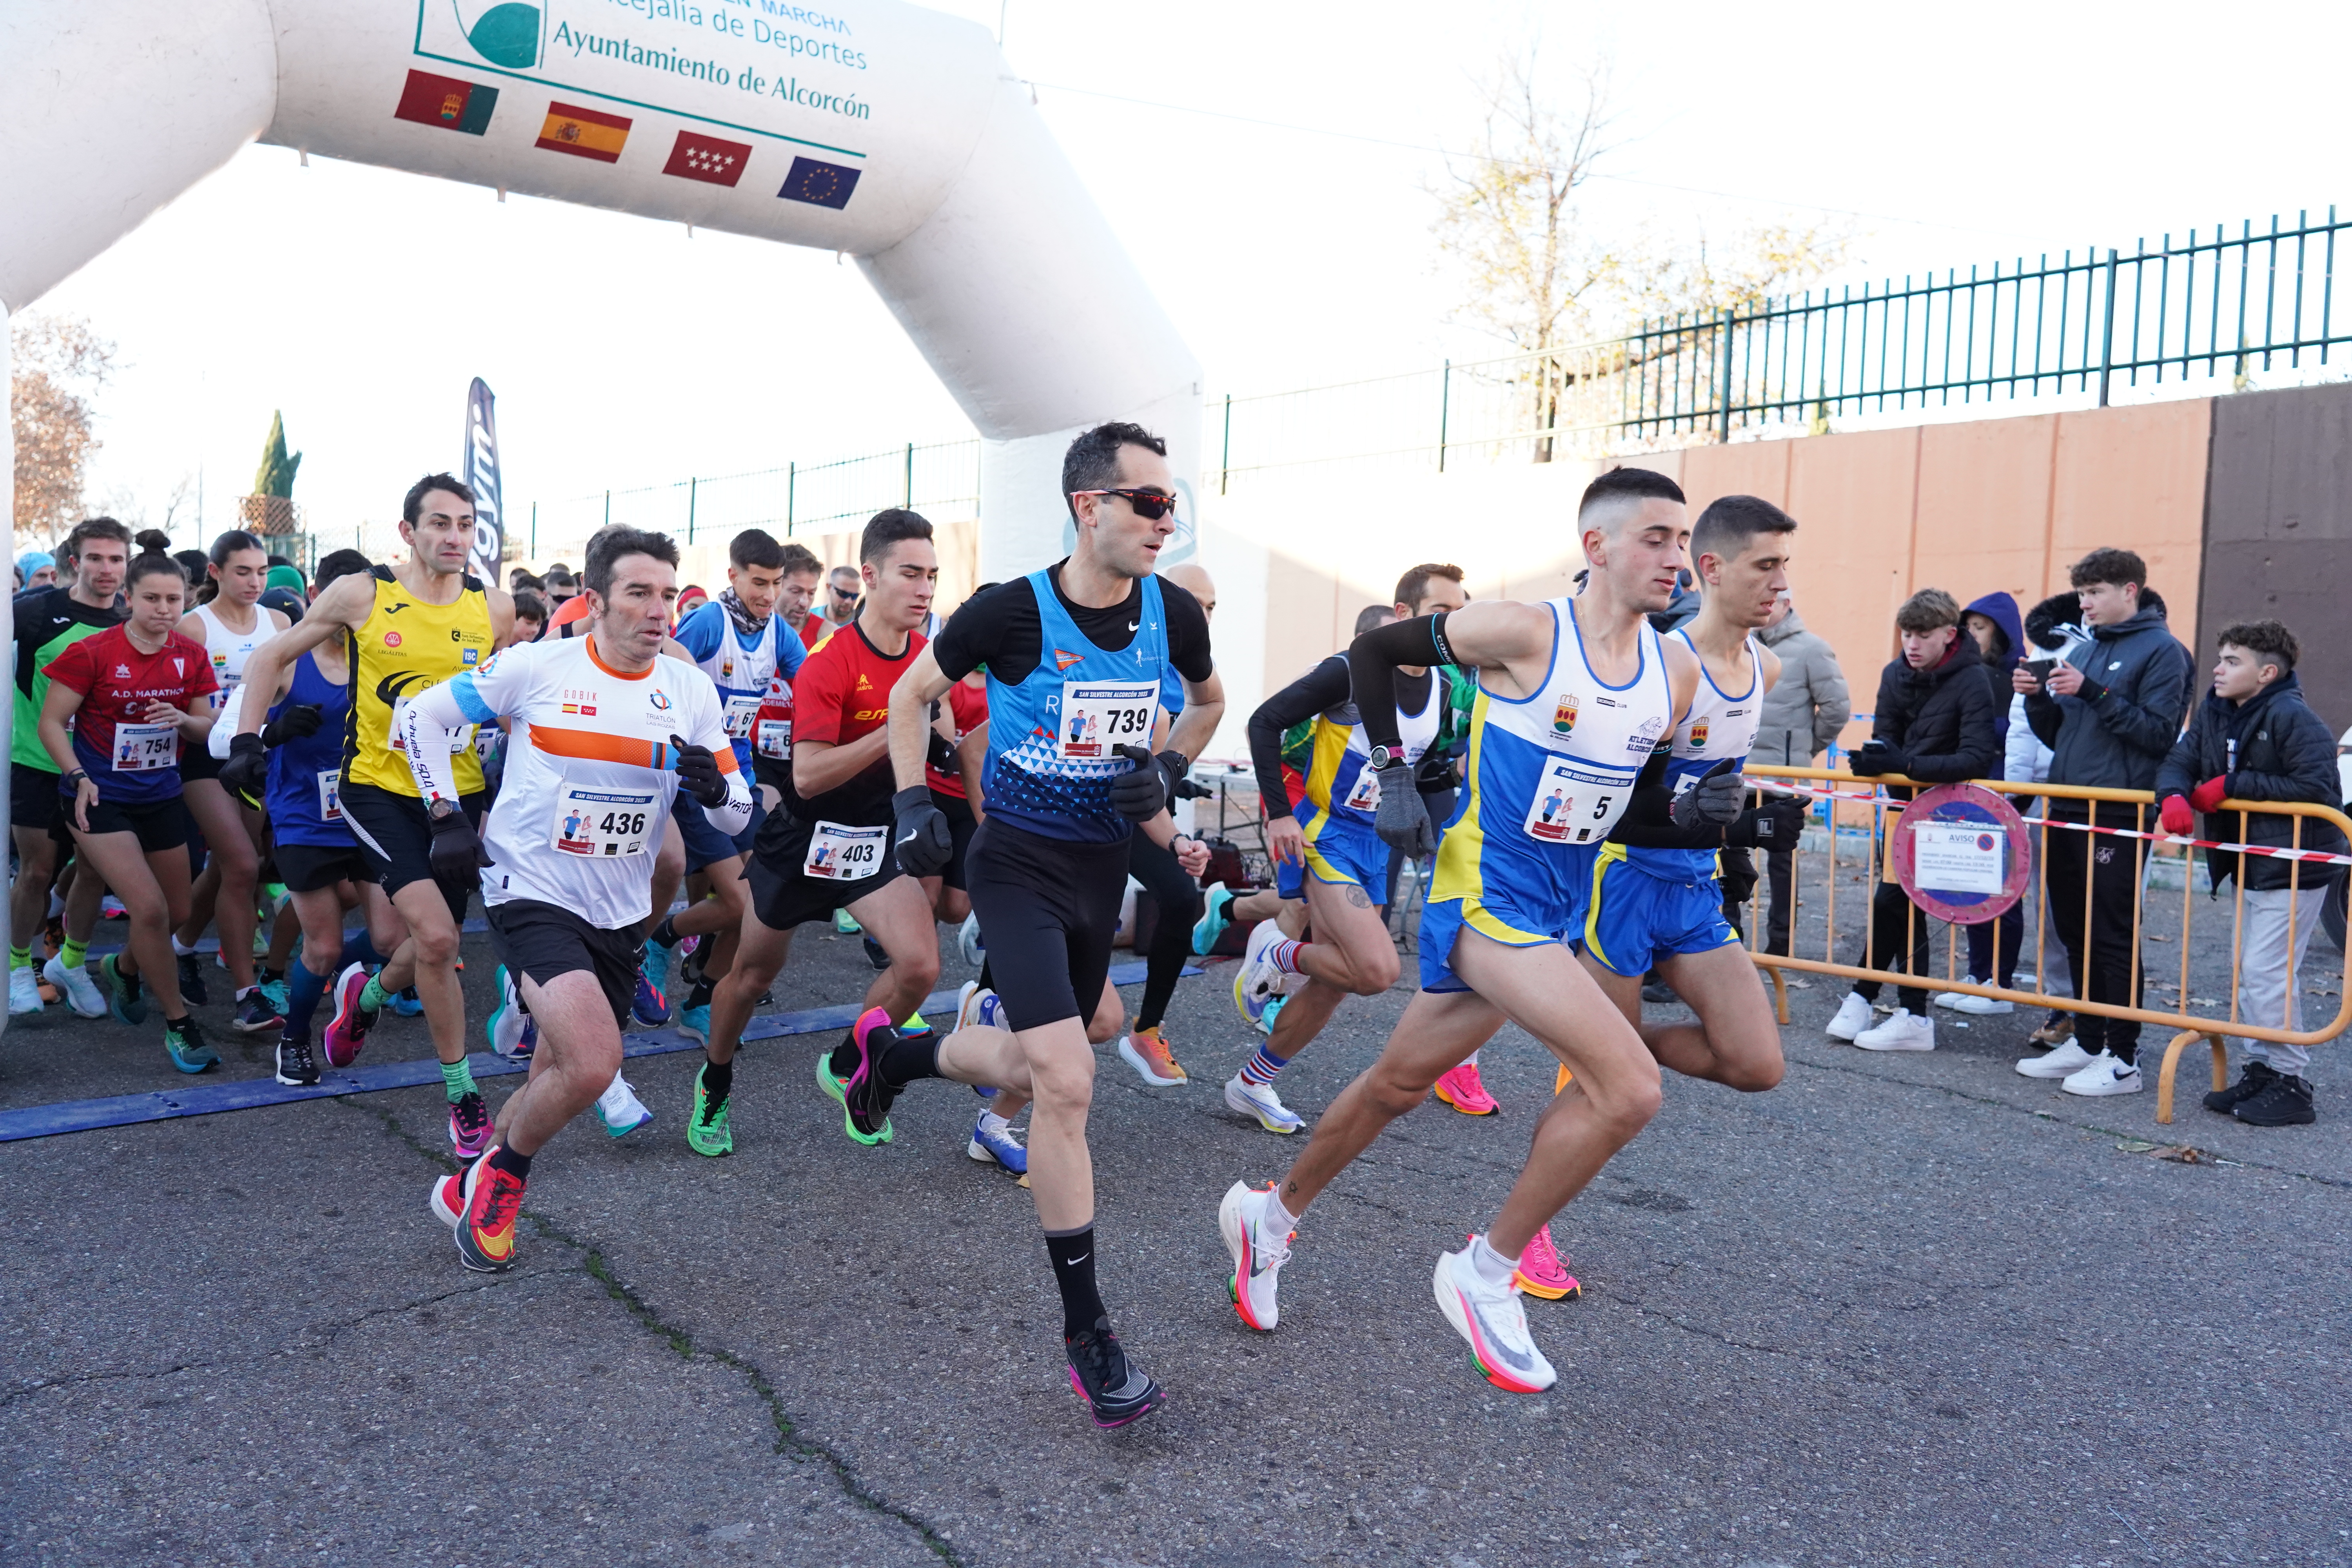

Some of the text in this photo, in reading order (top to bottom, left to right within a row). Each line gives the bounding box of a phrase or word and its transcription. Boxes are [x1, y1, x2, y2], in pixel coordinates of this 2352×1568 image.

[713, 9, 744, 37] de
[754, 19, 867, 69] Deportes
[554, 21, 869, 120] Ayuntamiento de Alcorcón
[377, 649, 407, 657] LEGÁLITAS
[465, 652, 476, 661] ISC
[136, 688, 184, 698] MARATHON
[564, 690, 597, 701] GOBIK
[646, 713, 675, 724] TRIATLÓN
[742, 712, 756, 725] 67
[1107, 708, 1147, 733] 739
[409, 710, 422, 759] Orihuela
[146, 737, 171, 755] 754
[1572, 773, 1597, 782] SILVESTRE
[1593, 796, 1612, 819] 5
[600, 813, 645, 835] 436
[842, 844, 874, 862] 403
